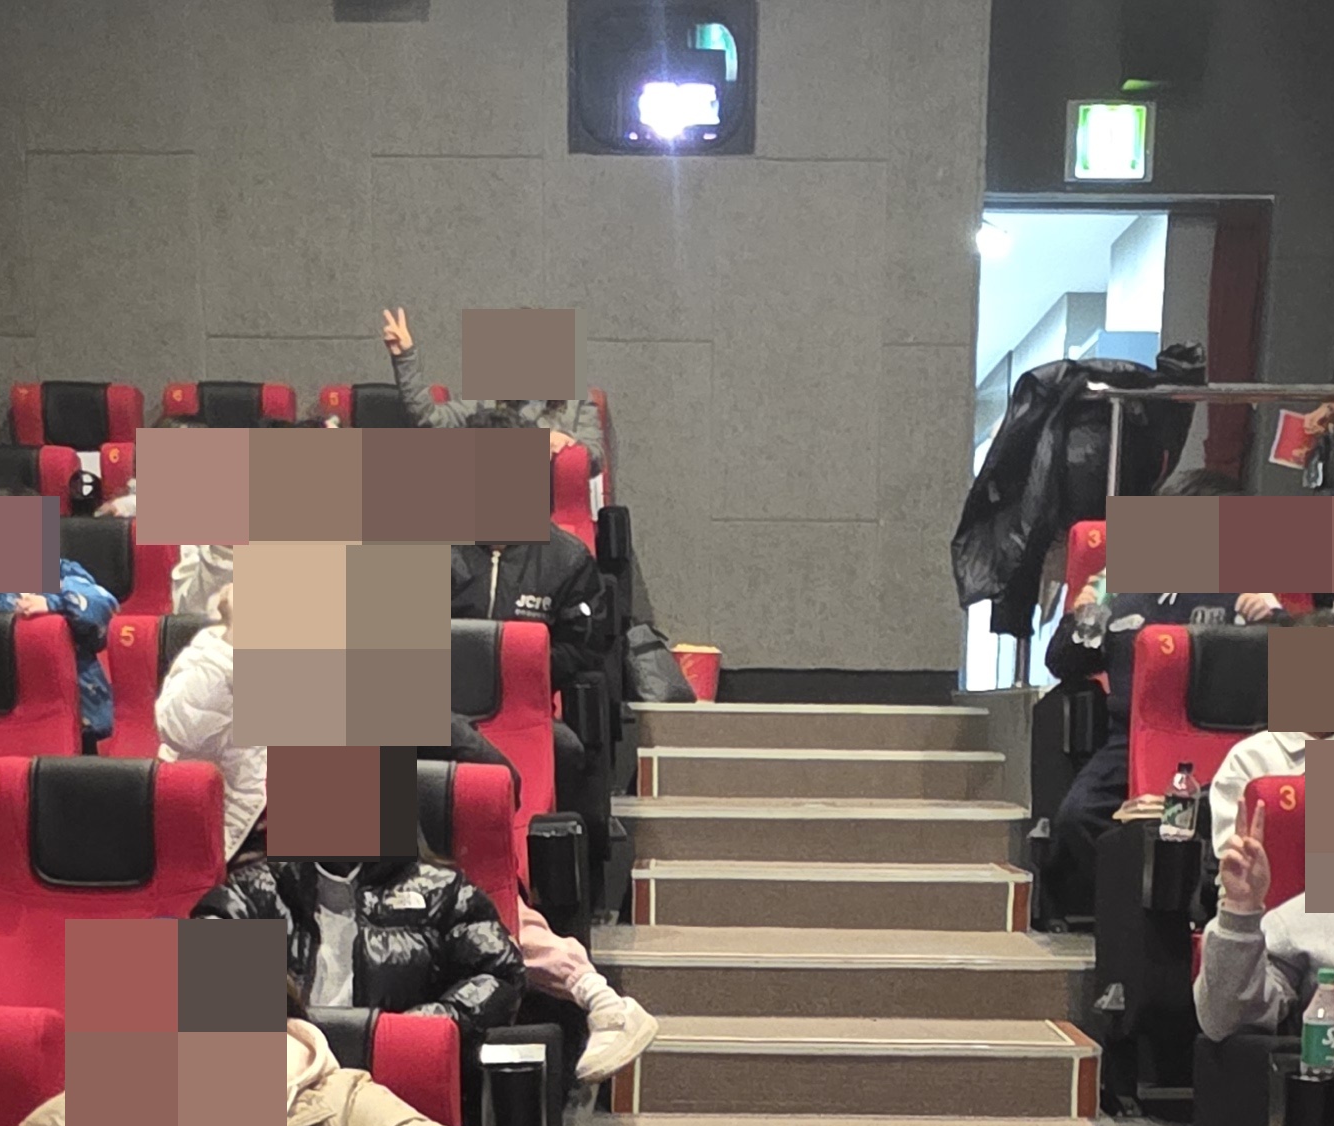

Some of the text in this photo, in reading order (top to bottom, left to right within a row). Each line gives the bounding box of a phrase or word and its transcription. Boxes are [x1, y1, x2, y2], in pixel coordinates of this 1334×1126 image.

[109, 447, 120, 463] 6
[1087, 529, 1102, 548] 3
[120, 625, 135, 647] 5
[1158, 633, 1175, 655] 3
[1279, 784, 1297, 811] 3
